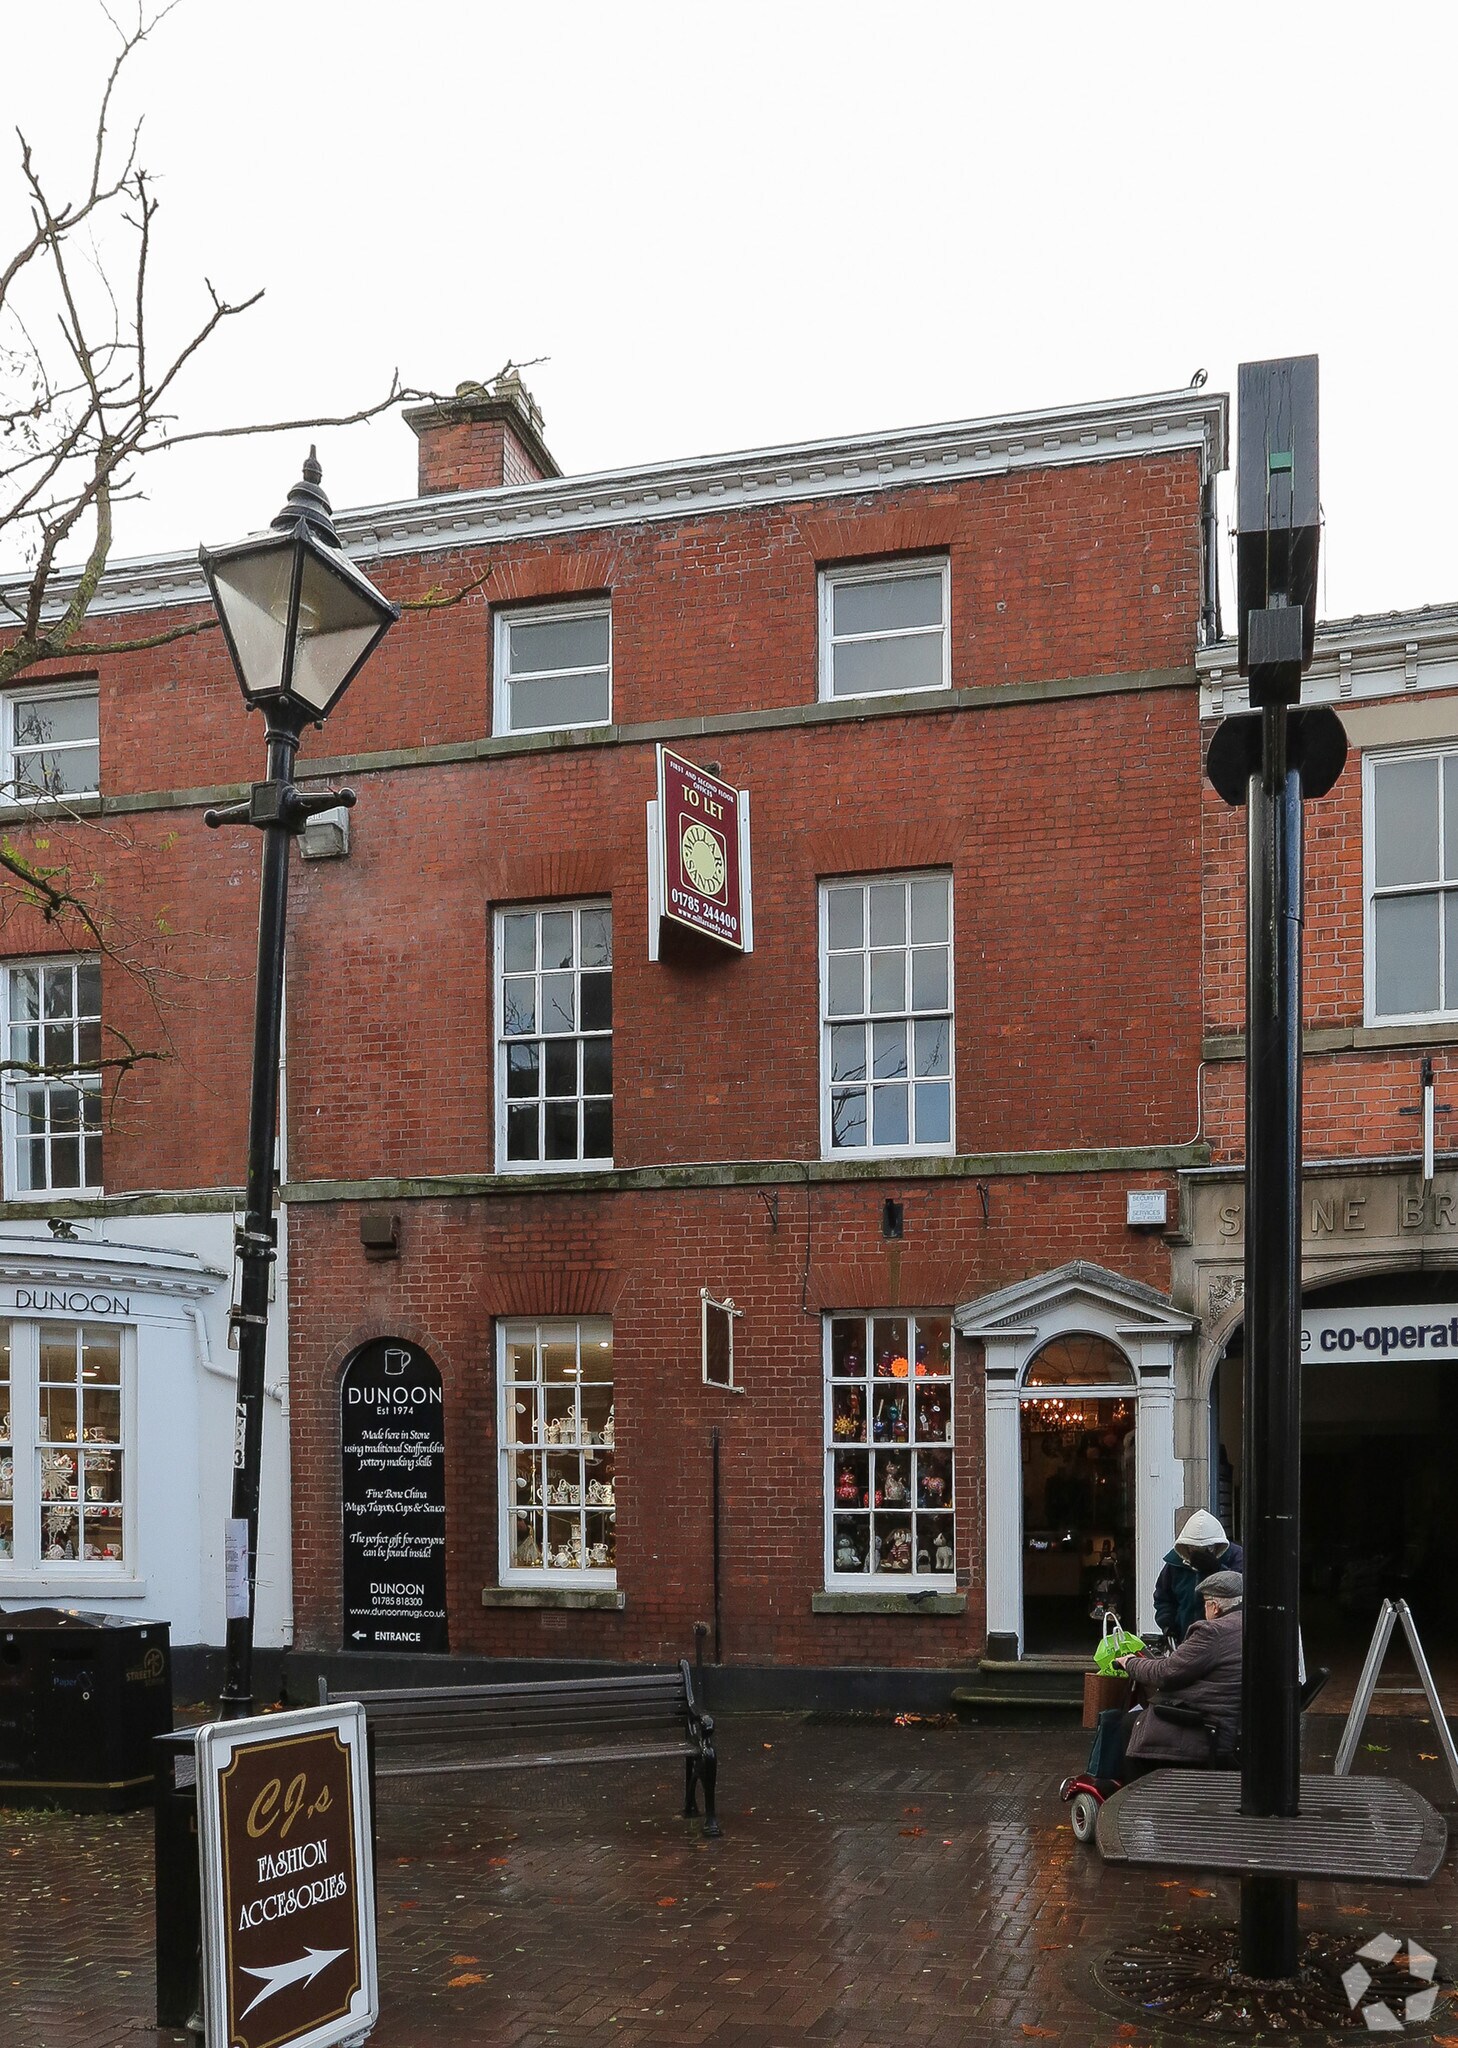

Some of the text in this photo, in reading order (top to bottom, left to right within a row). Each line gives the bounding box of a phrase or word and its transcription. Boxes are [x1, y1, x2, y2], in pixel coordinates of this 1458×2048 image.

[670, 760, 734, 803] FIRST AND SECOND FLOOR
[693, 782, 712, 798] OFFICES
[682, 784, 724, 820] TO LET
[684, 827, 722, 867] MILLAR
[686, 860, 721, 892] SANDY
[672, 888, 737, 931] 01785 244400
[16, 1290, 130, 1315] DUNOON
[348, 1386, 442, 1404] DUNOON
[376, 1406, 414, 1415] Est 1974
[361, 1428, 430, 1440] Made here in Stone
[344, 1444, 364, 1457] using
[365, 1442, 404, 1453] traditional
[358, 1455, 432, 1471] pottery making skills
[366, 1487, 427, 1499] Fine Bone China
[344, 1502, 367, 1516] Mugs,
[395, 1502, 413, 1516] Cups
[413, 1503, 423, 1513] &
[349, 1532, 445, 1549] The perfect gift for everyone
[363, 1546, 431, 1561] can be found inside!
[370, 1583, 425, 1595] DUNOON
[372, 1596, 422, 1606] 01785 818300
[350, 1608, 445, 1618] www.dunoonmugs.co.uk
[375, 1631, 421, 1642] ENTRANCE
[53, 1677, 77, 1687] Paper
[257, 1839, 328, 1883] FASHION
[238, 1872, 348, 1931] ACCESORIES
